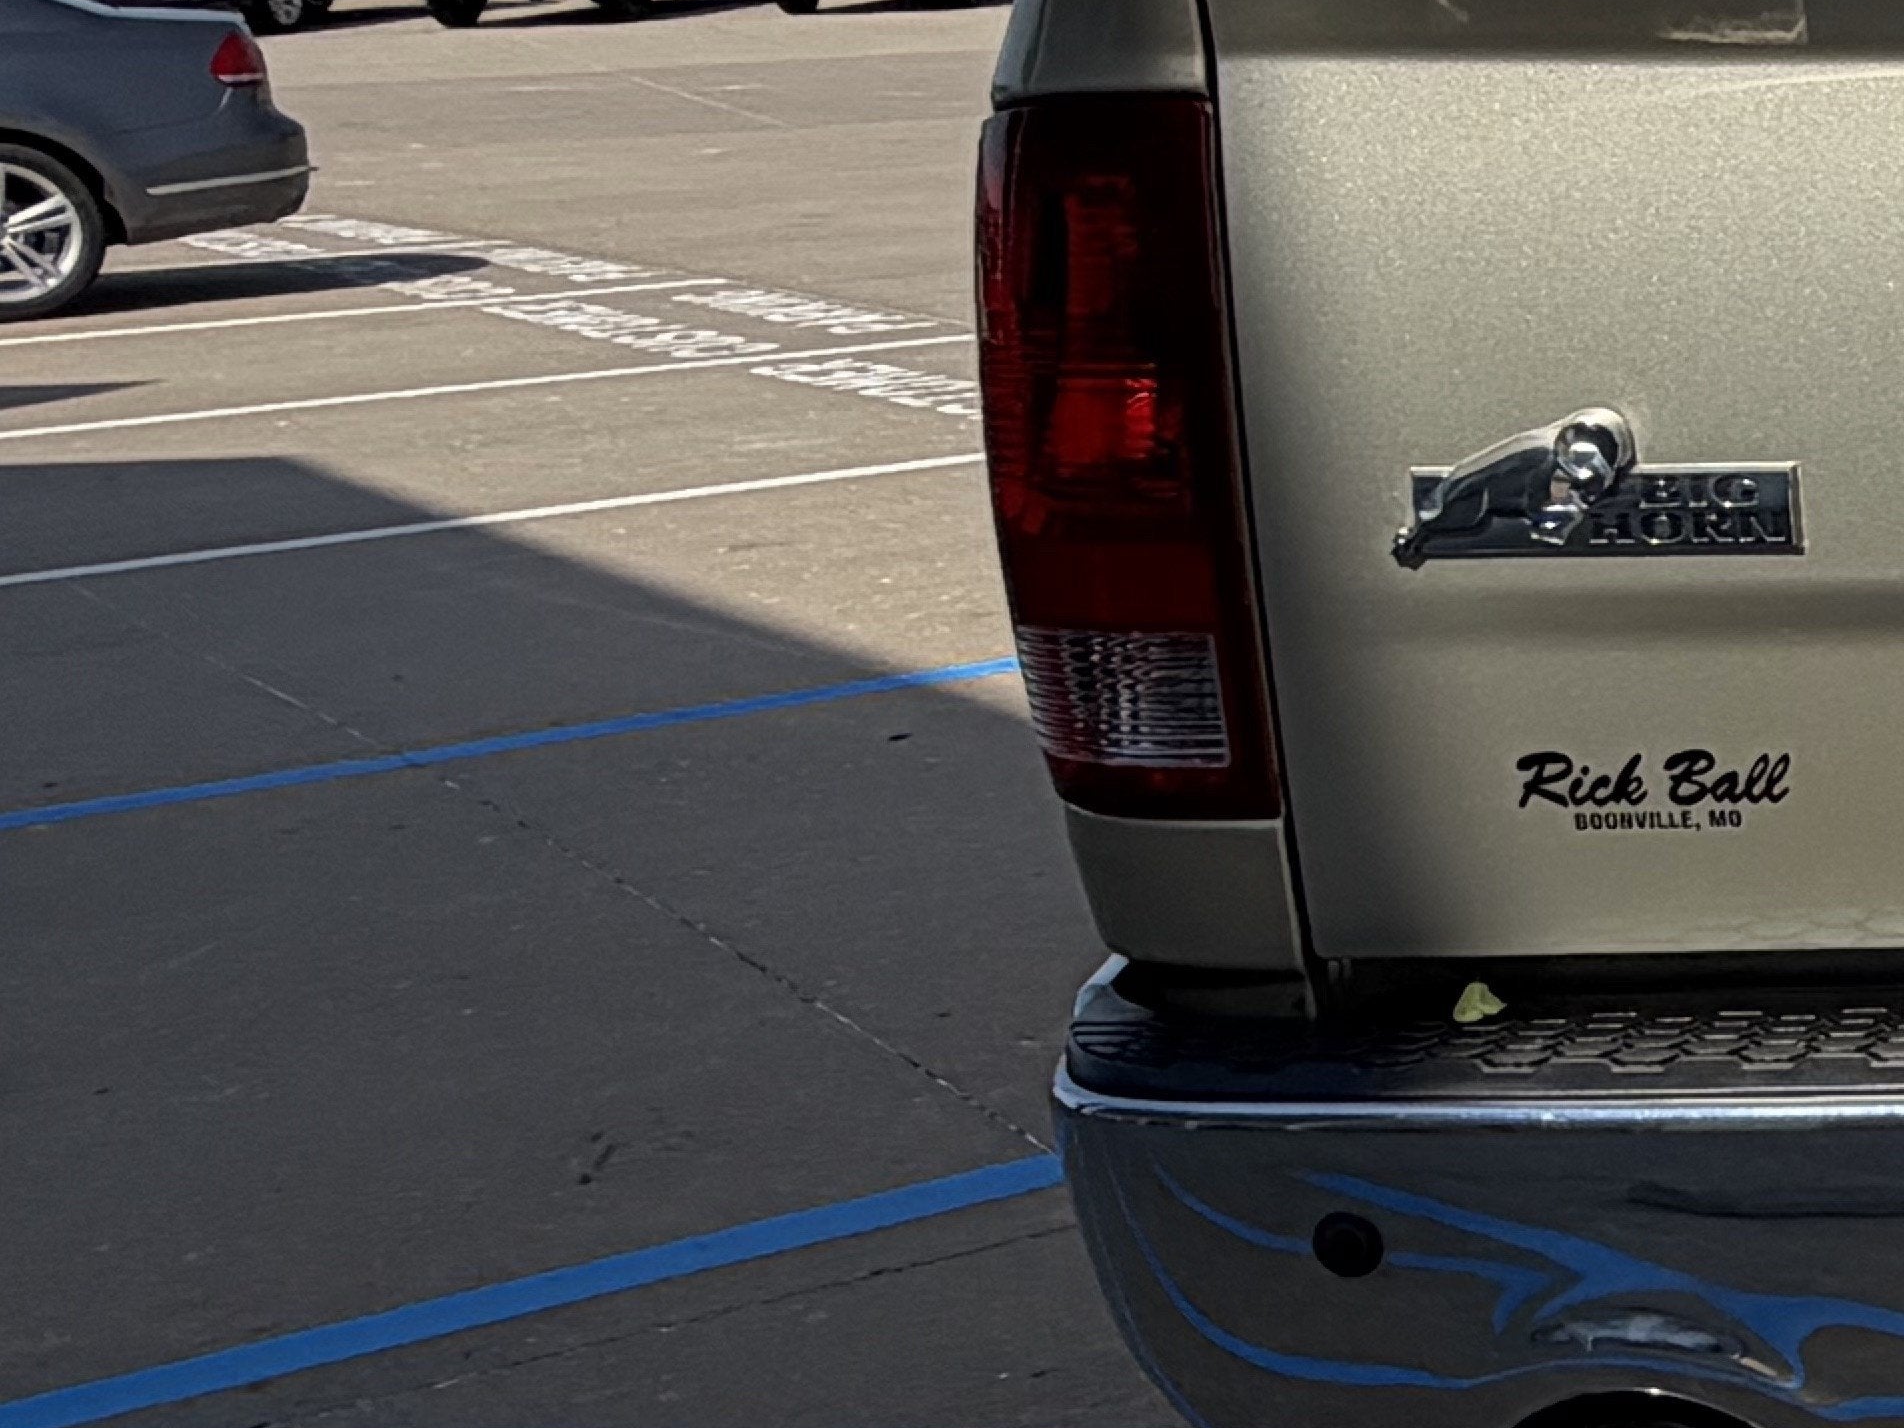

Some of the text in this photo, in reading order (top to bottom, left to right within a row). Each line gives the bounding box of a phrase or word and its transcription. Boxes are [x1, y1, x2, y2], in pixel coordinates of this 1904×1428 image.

[1639, 474, 1760, 510] BIG
[1588, 510, 1788, 546] HORN
[1516, 747, 1790, 809] Rick Ball
[1574, 808, 1742, 832] BOONVILLE, MO
